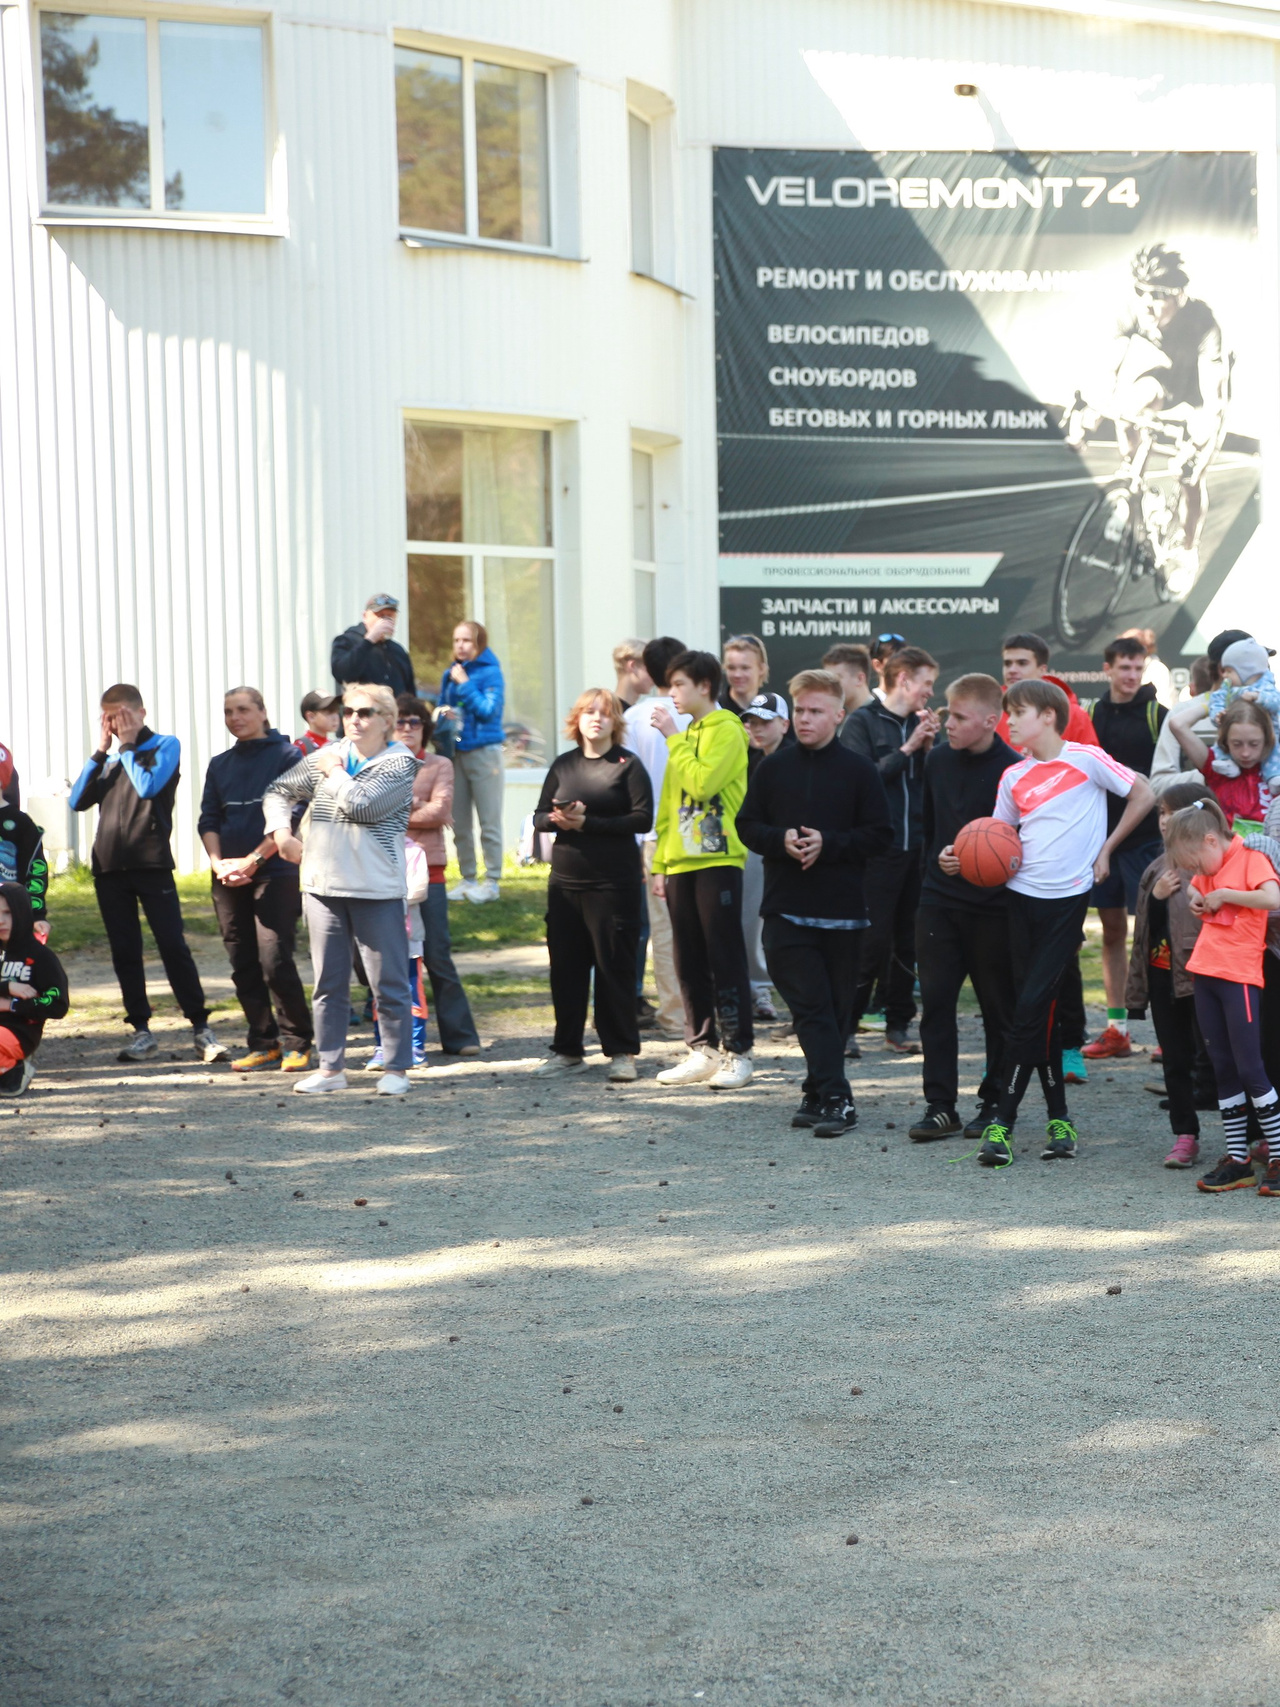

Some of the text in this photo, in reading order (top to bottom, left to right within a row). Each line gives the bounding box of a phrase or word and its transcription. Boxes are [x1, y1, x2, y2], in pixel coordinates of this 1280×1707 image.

[757, 267, 858, 291] РЕМОНТ
[866, 269, 882, 291] И
[768, 324, 929, 348] ВЕЛОСИПЕДОВ
[769, 366, 917, 391] СНОУБОРДОВ
[769, 408, 1048, 430] БЕГОВЫХ И ГОРНЫХ ЛЫЖ
[762, 597, 999, 616] ЗАПЧАСТИ И АКСЕССУАРЫ
[762, 620, 871, 637] В НАЛИЧИИ
